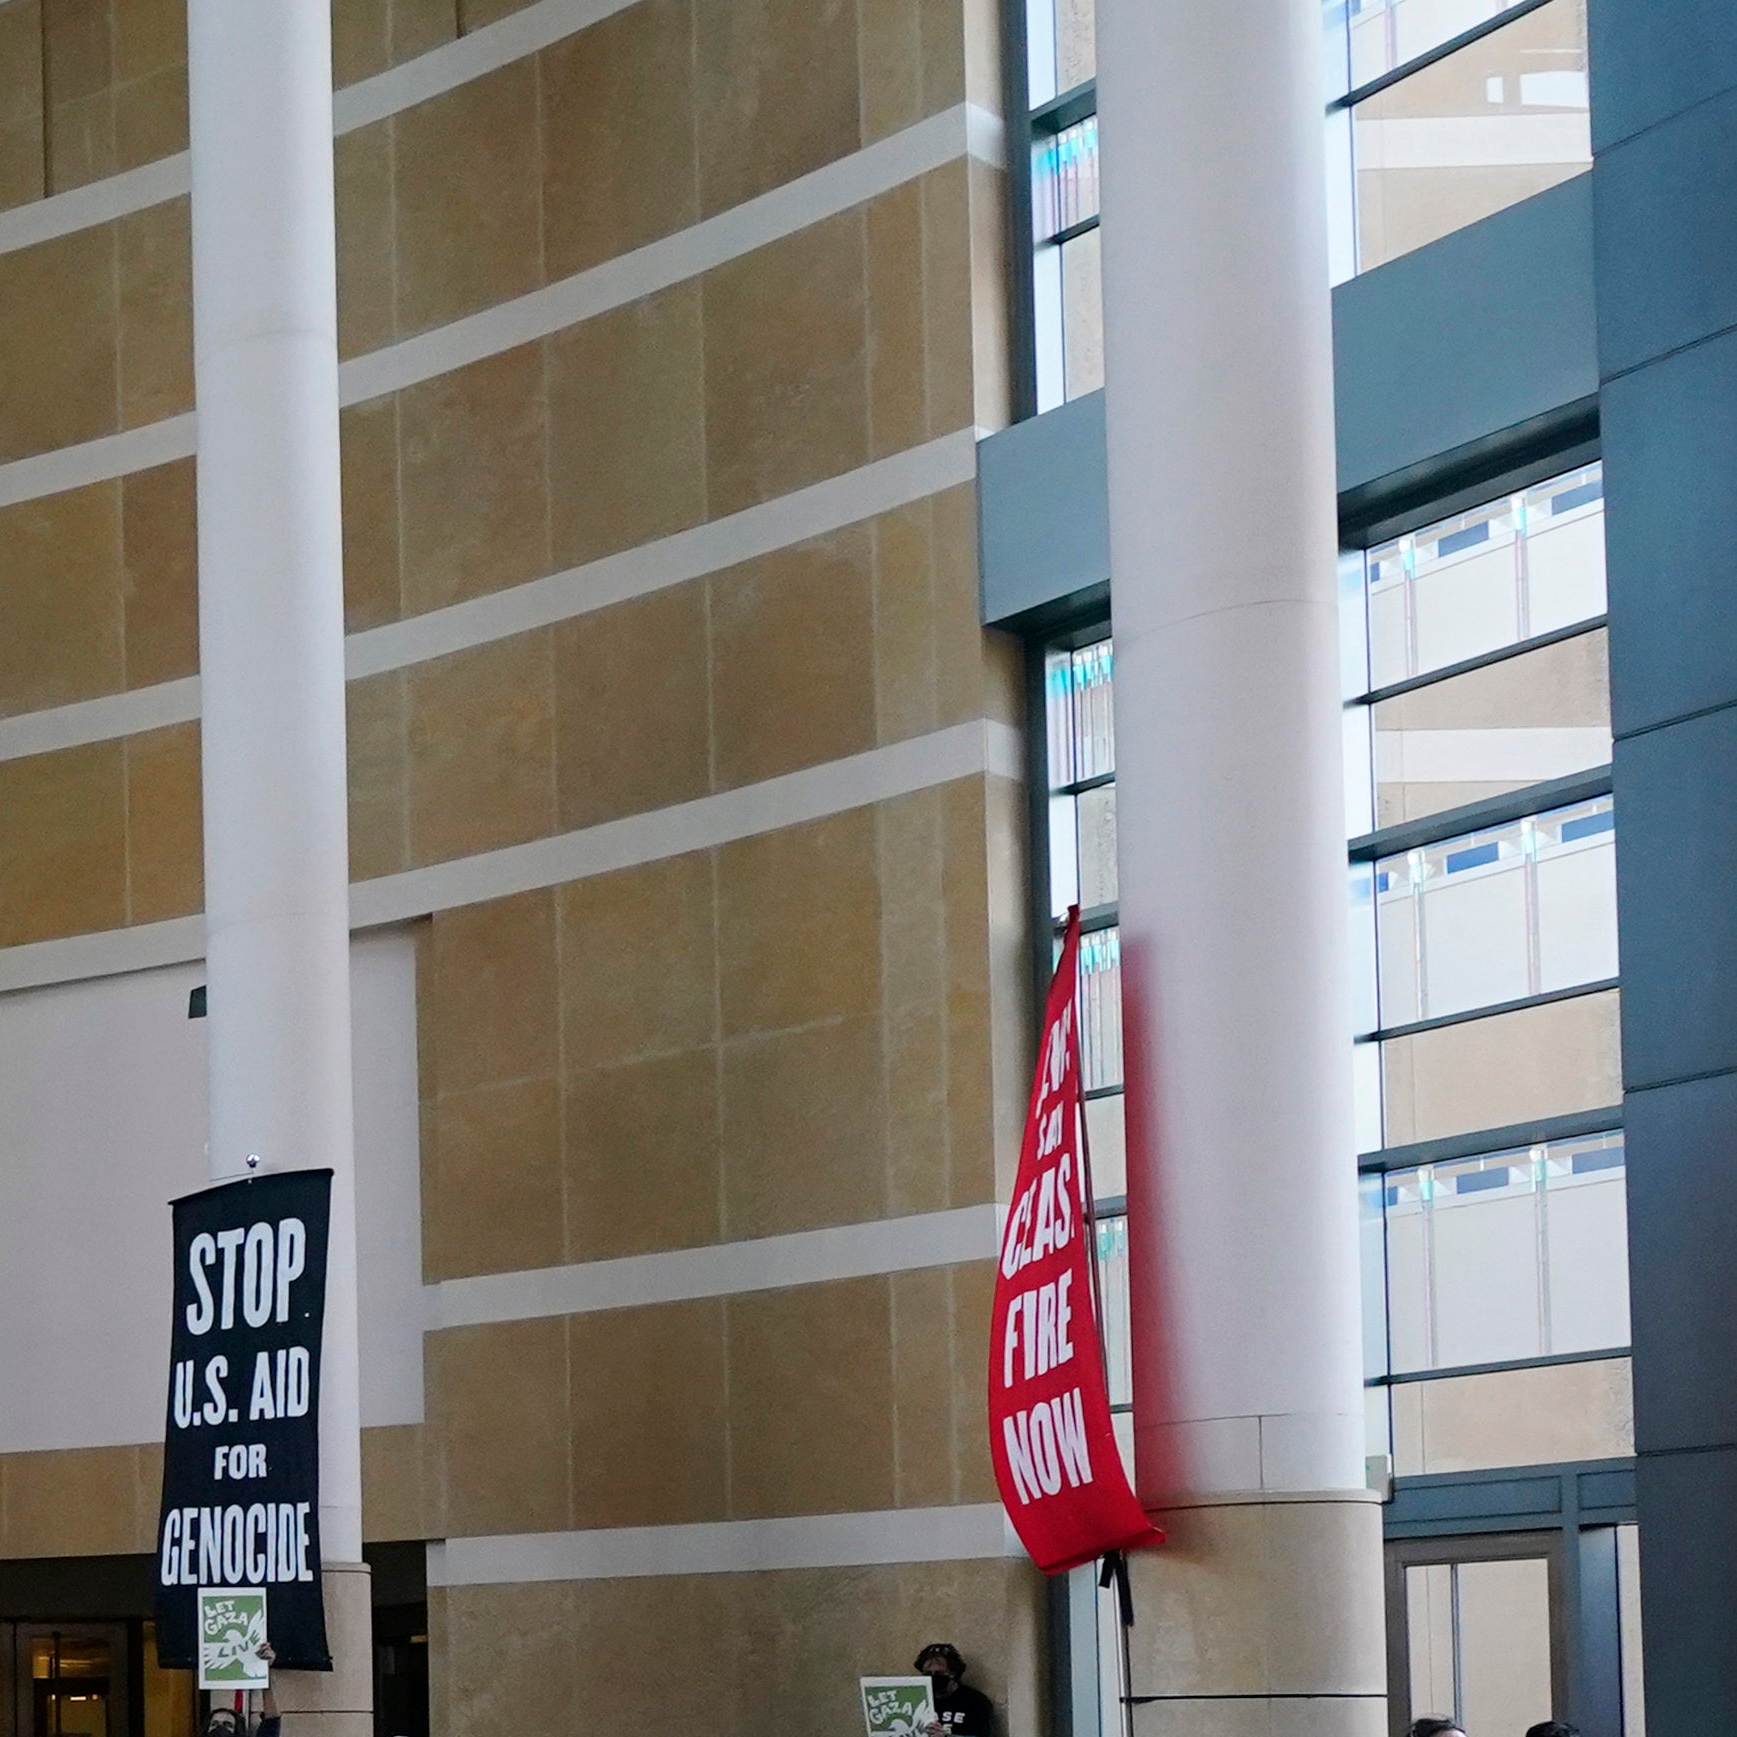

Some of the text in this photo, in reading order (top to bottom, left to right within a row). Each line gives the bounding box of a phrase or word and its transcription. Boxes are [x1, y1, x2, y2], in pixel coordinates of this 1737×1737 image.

[186, 1217, 307, 1336] STOP
[1004, 1272, 1073, 1389] FIRE
[173, 1346, 310, 1430] U.S. AID
[214, 1444, 267, 1481] FOR
[1003, 1387, 1093, 1506] NOW
[160, 1502, 314, 1586] GENOCIDE
[204, 1601, 235, 1618] LET
[204, 1611, 248, 1635] GAZA
[217, 1630, 261, 1658] LIVE
[867, 1690, 898, 1708] LET
[869, 1702, 914, 1725] GAZA
